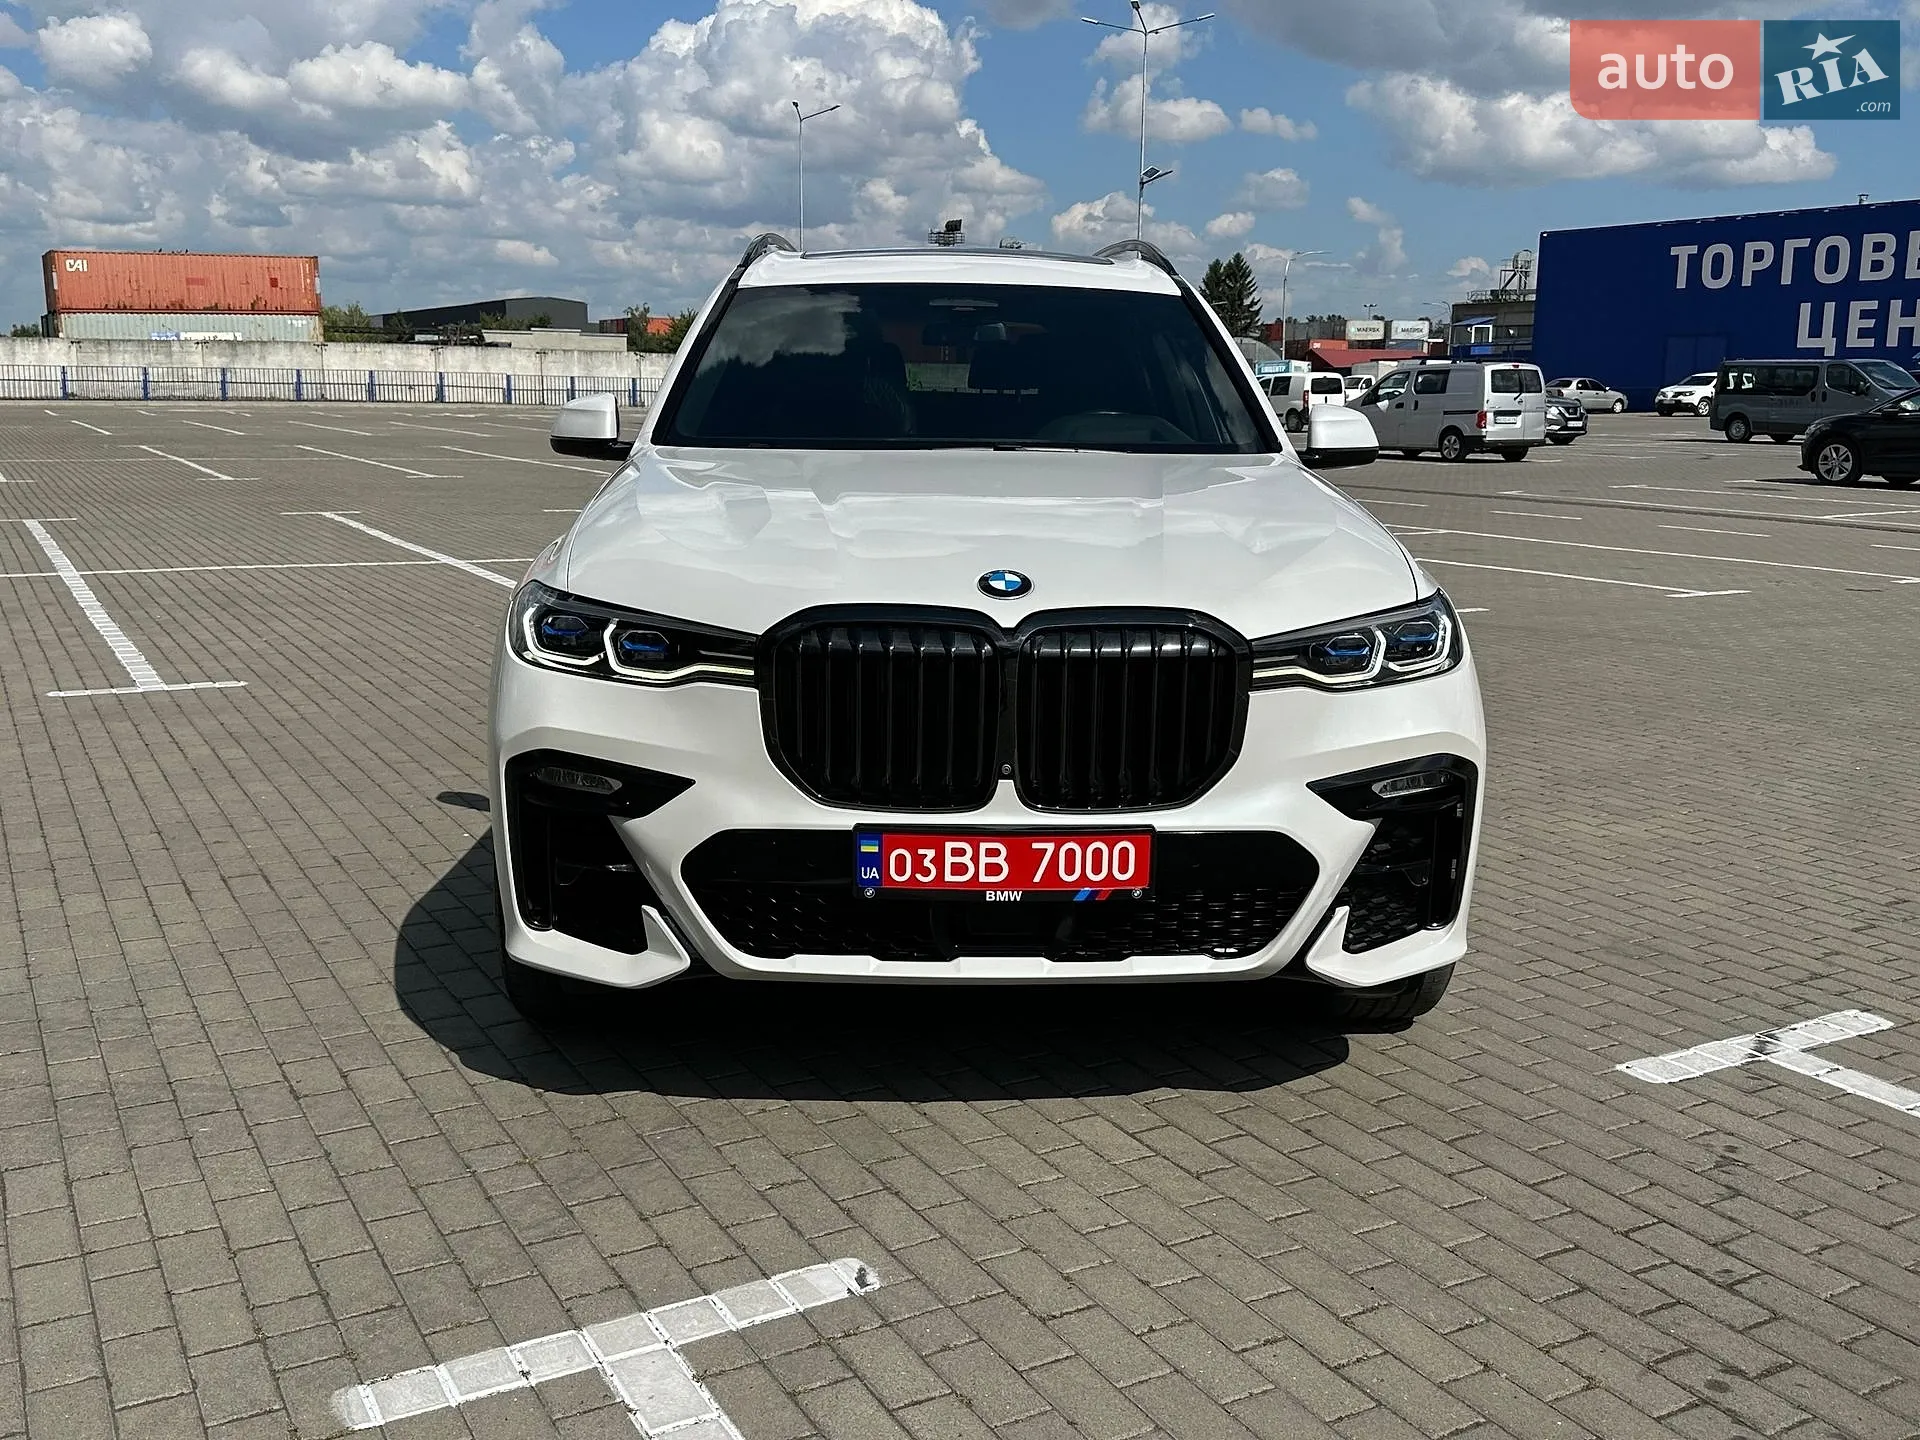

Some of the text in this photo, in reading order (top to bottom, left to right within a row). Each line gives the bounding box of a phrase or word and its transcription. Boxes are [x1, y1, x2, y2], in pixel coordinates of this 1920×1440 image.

[65, 259, 88, 272] CAI
[1797, 298, 1920, 357] ЦЕН
[1031, 840, 1137, 883] 7000
[861, 866, 880, 880] UA
[985, 890, 1023, 902] BMW
